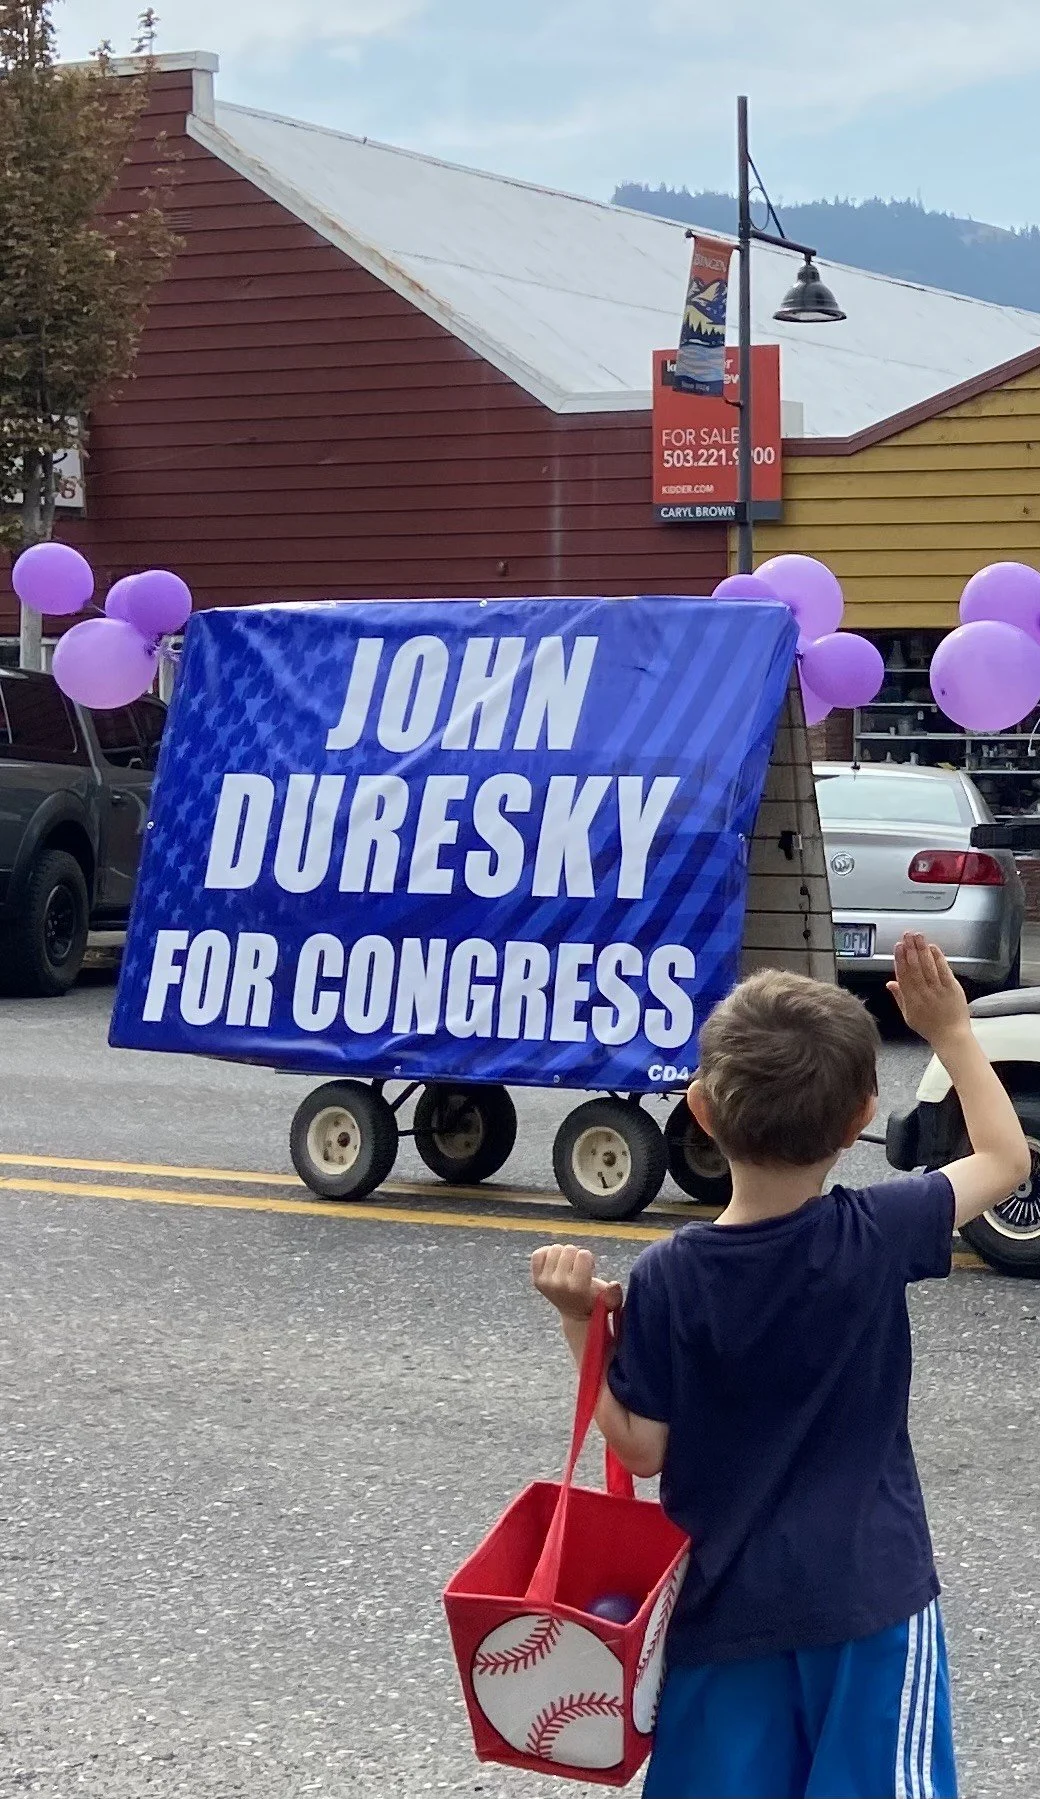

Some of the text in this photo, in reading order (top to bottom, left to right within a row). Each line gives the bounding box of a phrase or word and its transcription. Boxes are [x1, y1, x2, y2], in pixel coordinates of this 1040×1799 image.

[662, 427, 739, 447] FOR SALE
[663, 446, 775, 468] 503.221.900
[661, 484, 714, 495] KIDDER.COM
[660, 506, 736, 518] CARYL BROWN
[326, 636, 598, 752] JOHN
[205, 774, 680, 898] DURESKY
[143, 930, 695, 1048] FOR CONGRESS
